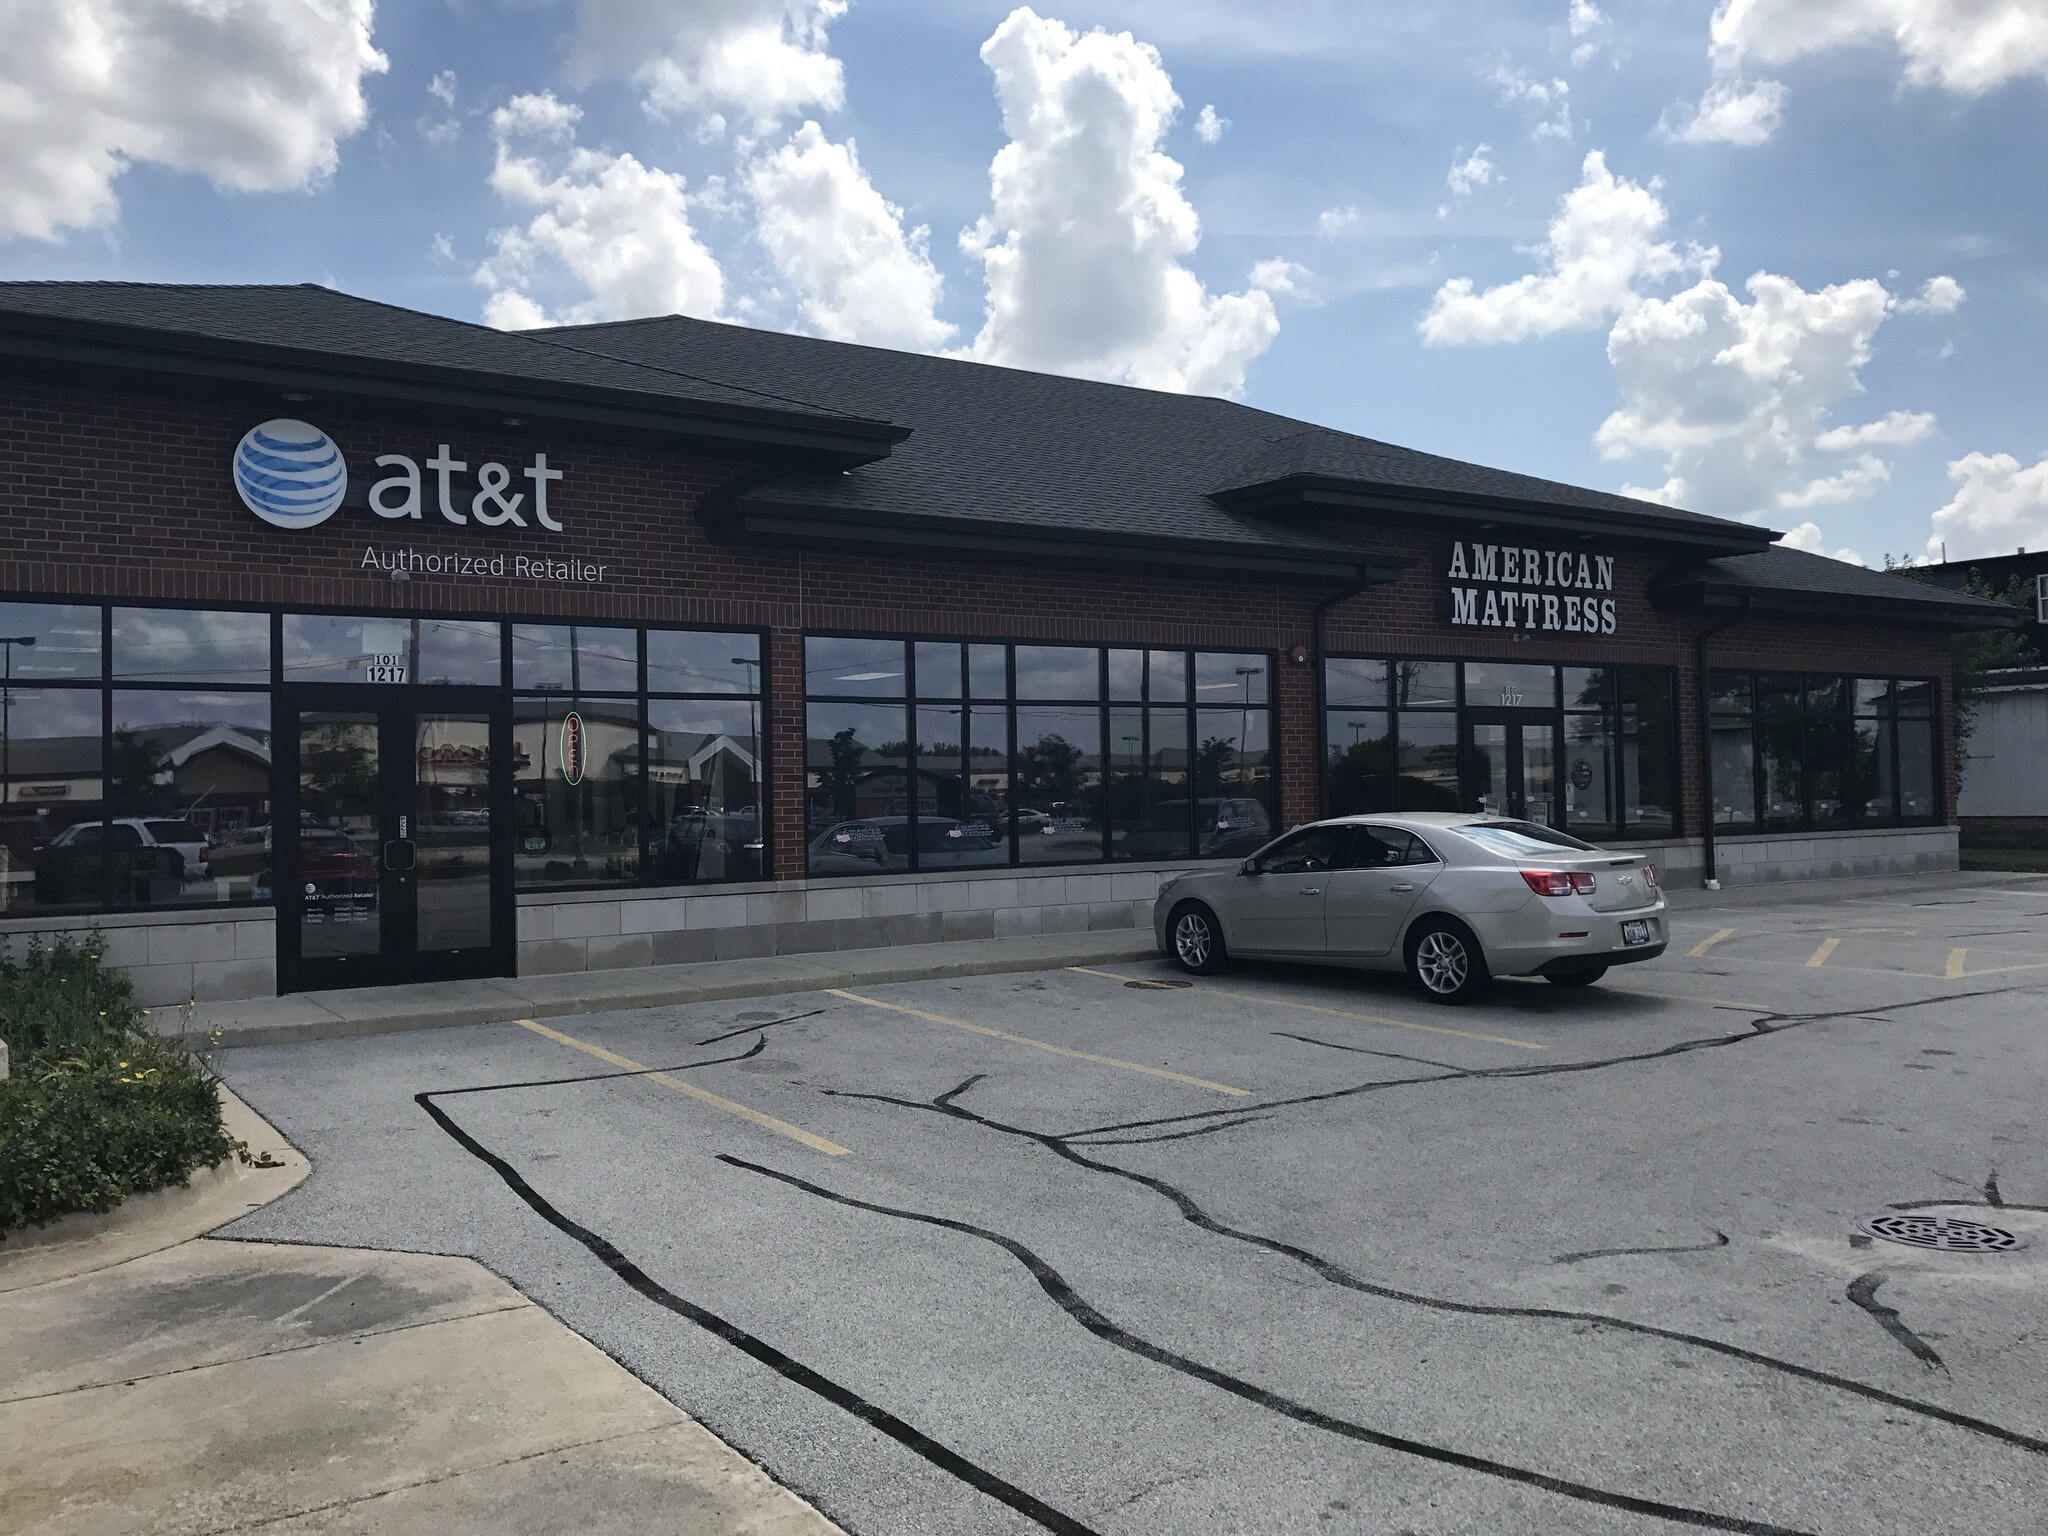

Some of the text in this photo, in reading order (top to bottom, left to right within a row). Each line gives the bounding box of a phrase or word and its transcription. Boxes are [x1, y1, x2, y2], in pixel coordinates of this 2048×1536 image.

[368, 443, 563, 532] at&t
[360, 546, 608, 582] Authorized Retailer
[1448, 541, 1614, 590] AMERICAN
[1451, 587, 1617, 635] MATTRESS
[368, 666, 405, 682] 1217
[376, 654, 397, 665] 101
[1500, 693, 1523, 706] 1217
